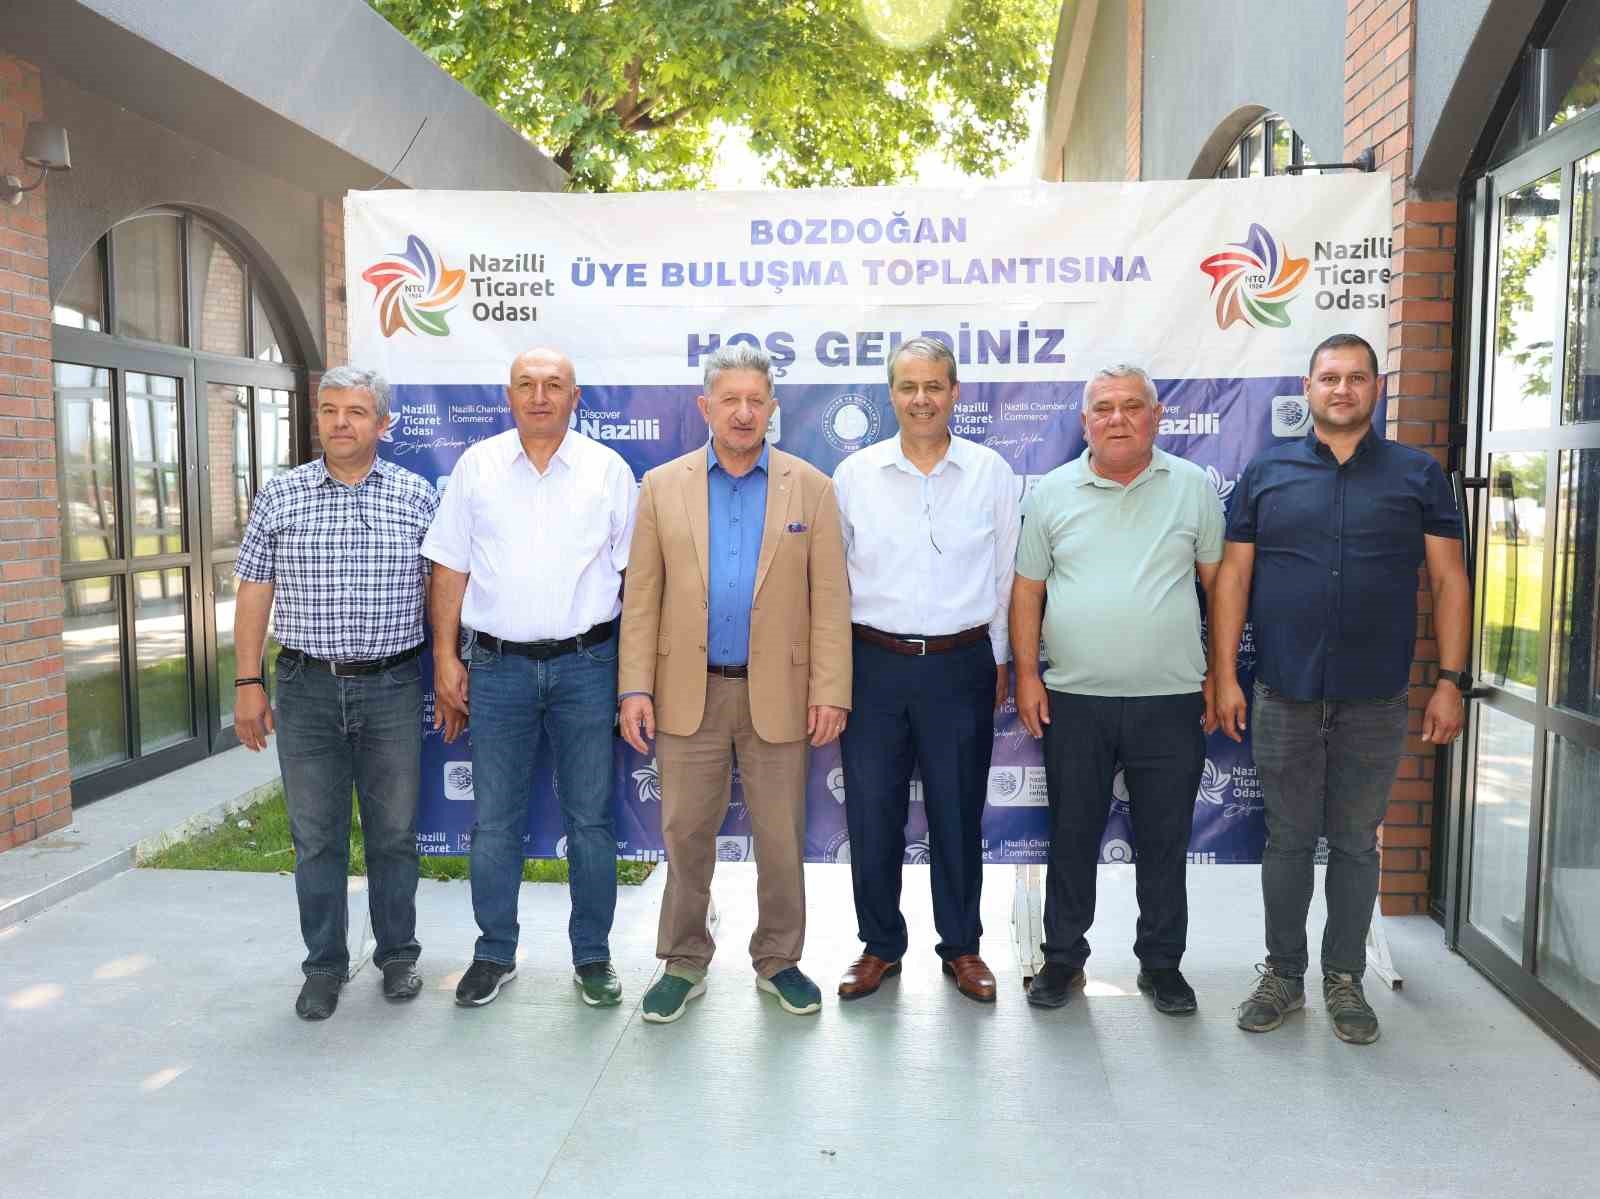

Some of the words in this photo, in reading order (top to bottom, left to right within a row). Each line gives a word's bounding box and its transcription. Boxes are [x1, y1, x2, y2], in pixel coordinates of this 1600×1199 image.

[750, 210, 967, 246] BOZDOĞAN
[1314, 237, 1392, 261] Nazilli
[469, 253, 545, 273] Nazilli
[571, 256, 647, 288] ÜYE
[661, 260, 848, 294] BULUŞMA
[862, 255, 1152, 286] TOPLANTISINA
[1245, 275, 1266, 283] NTO
[1314, 264, 1391, 285] Ticare
[470, 276, 555, 297] Ticaret
[1314, 289, 1386, 310] Odası
[472, 300, 537, 321] Odası
[402, 404, 437, 414] Nazilli
[452, 406, 475, 414] Nazilli
[580, 409, 621, 419] Discover
[954, 403, 989, 413] Nazilli
[1030, 402, 1065, 411] Chamber
[402, 416, 441, 425] Ticaret
[955, 414, 993, 424] Ticaret
[1004, 413, 1049, 421] Commerce
[1159, 412, 1220, 435] azilli
[402, 426, 434, 436] Odası
[580, 419, 660, 440] Nazilli
[1232, 766, 1257, 776] Nazi
